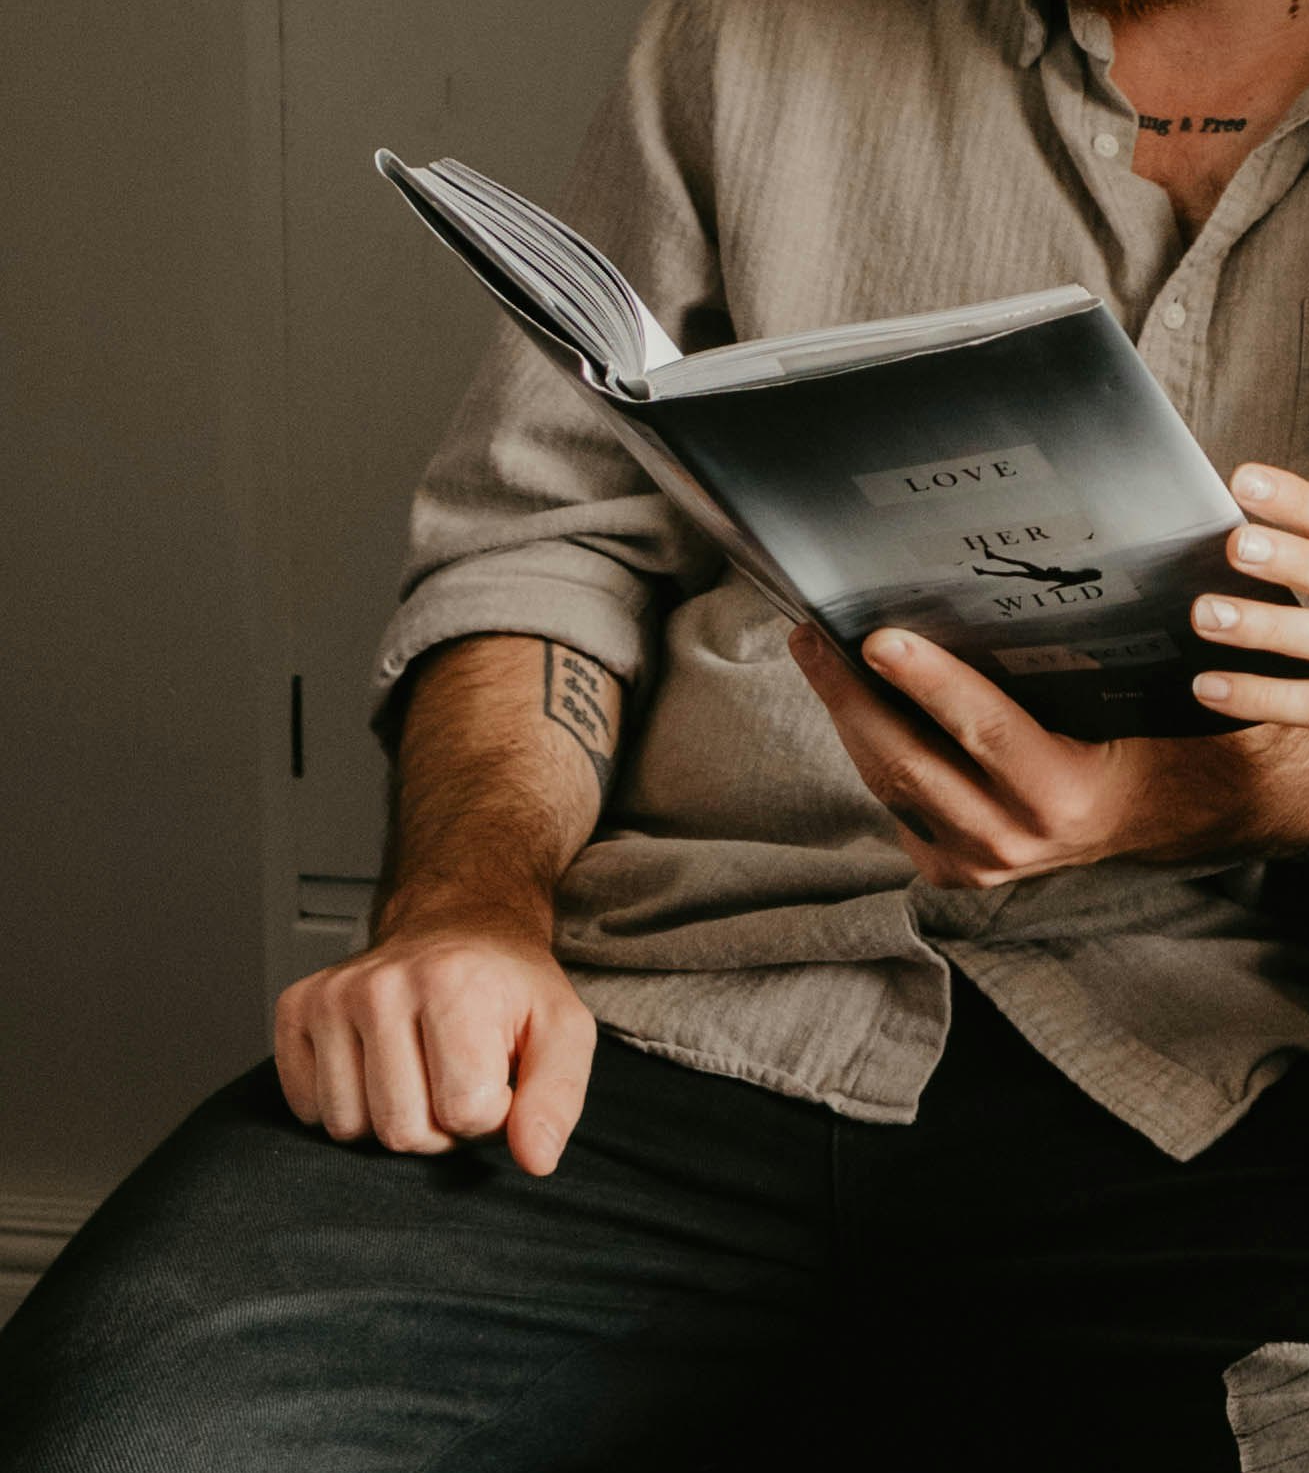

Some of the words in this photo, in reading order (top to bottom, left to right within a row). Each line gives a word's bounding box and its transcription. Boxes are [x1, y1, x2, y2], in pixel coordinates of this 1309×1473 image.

[904, 460, 1017, 494] LOVE
[962, 525, 1051, 552] HER
[993, 585, 1104, 613] WILD
